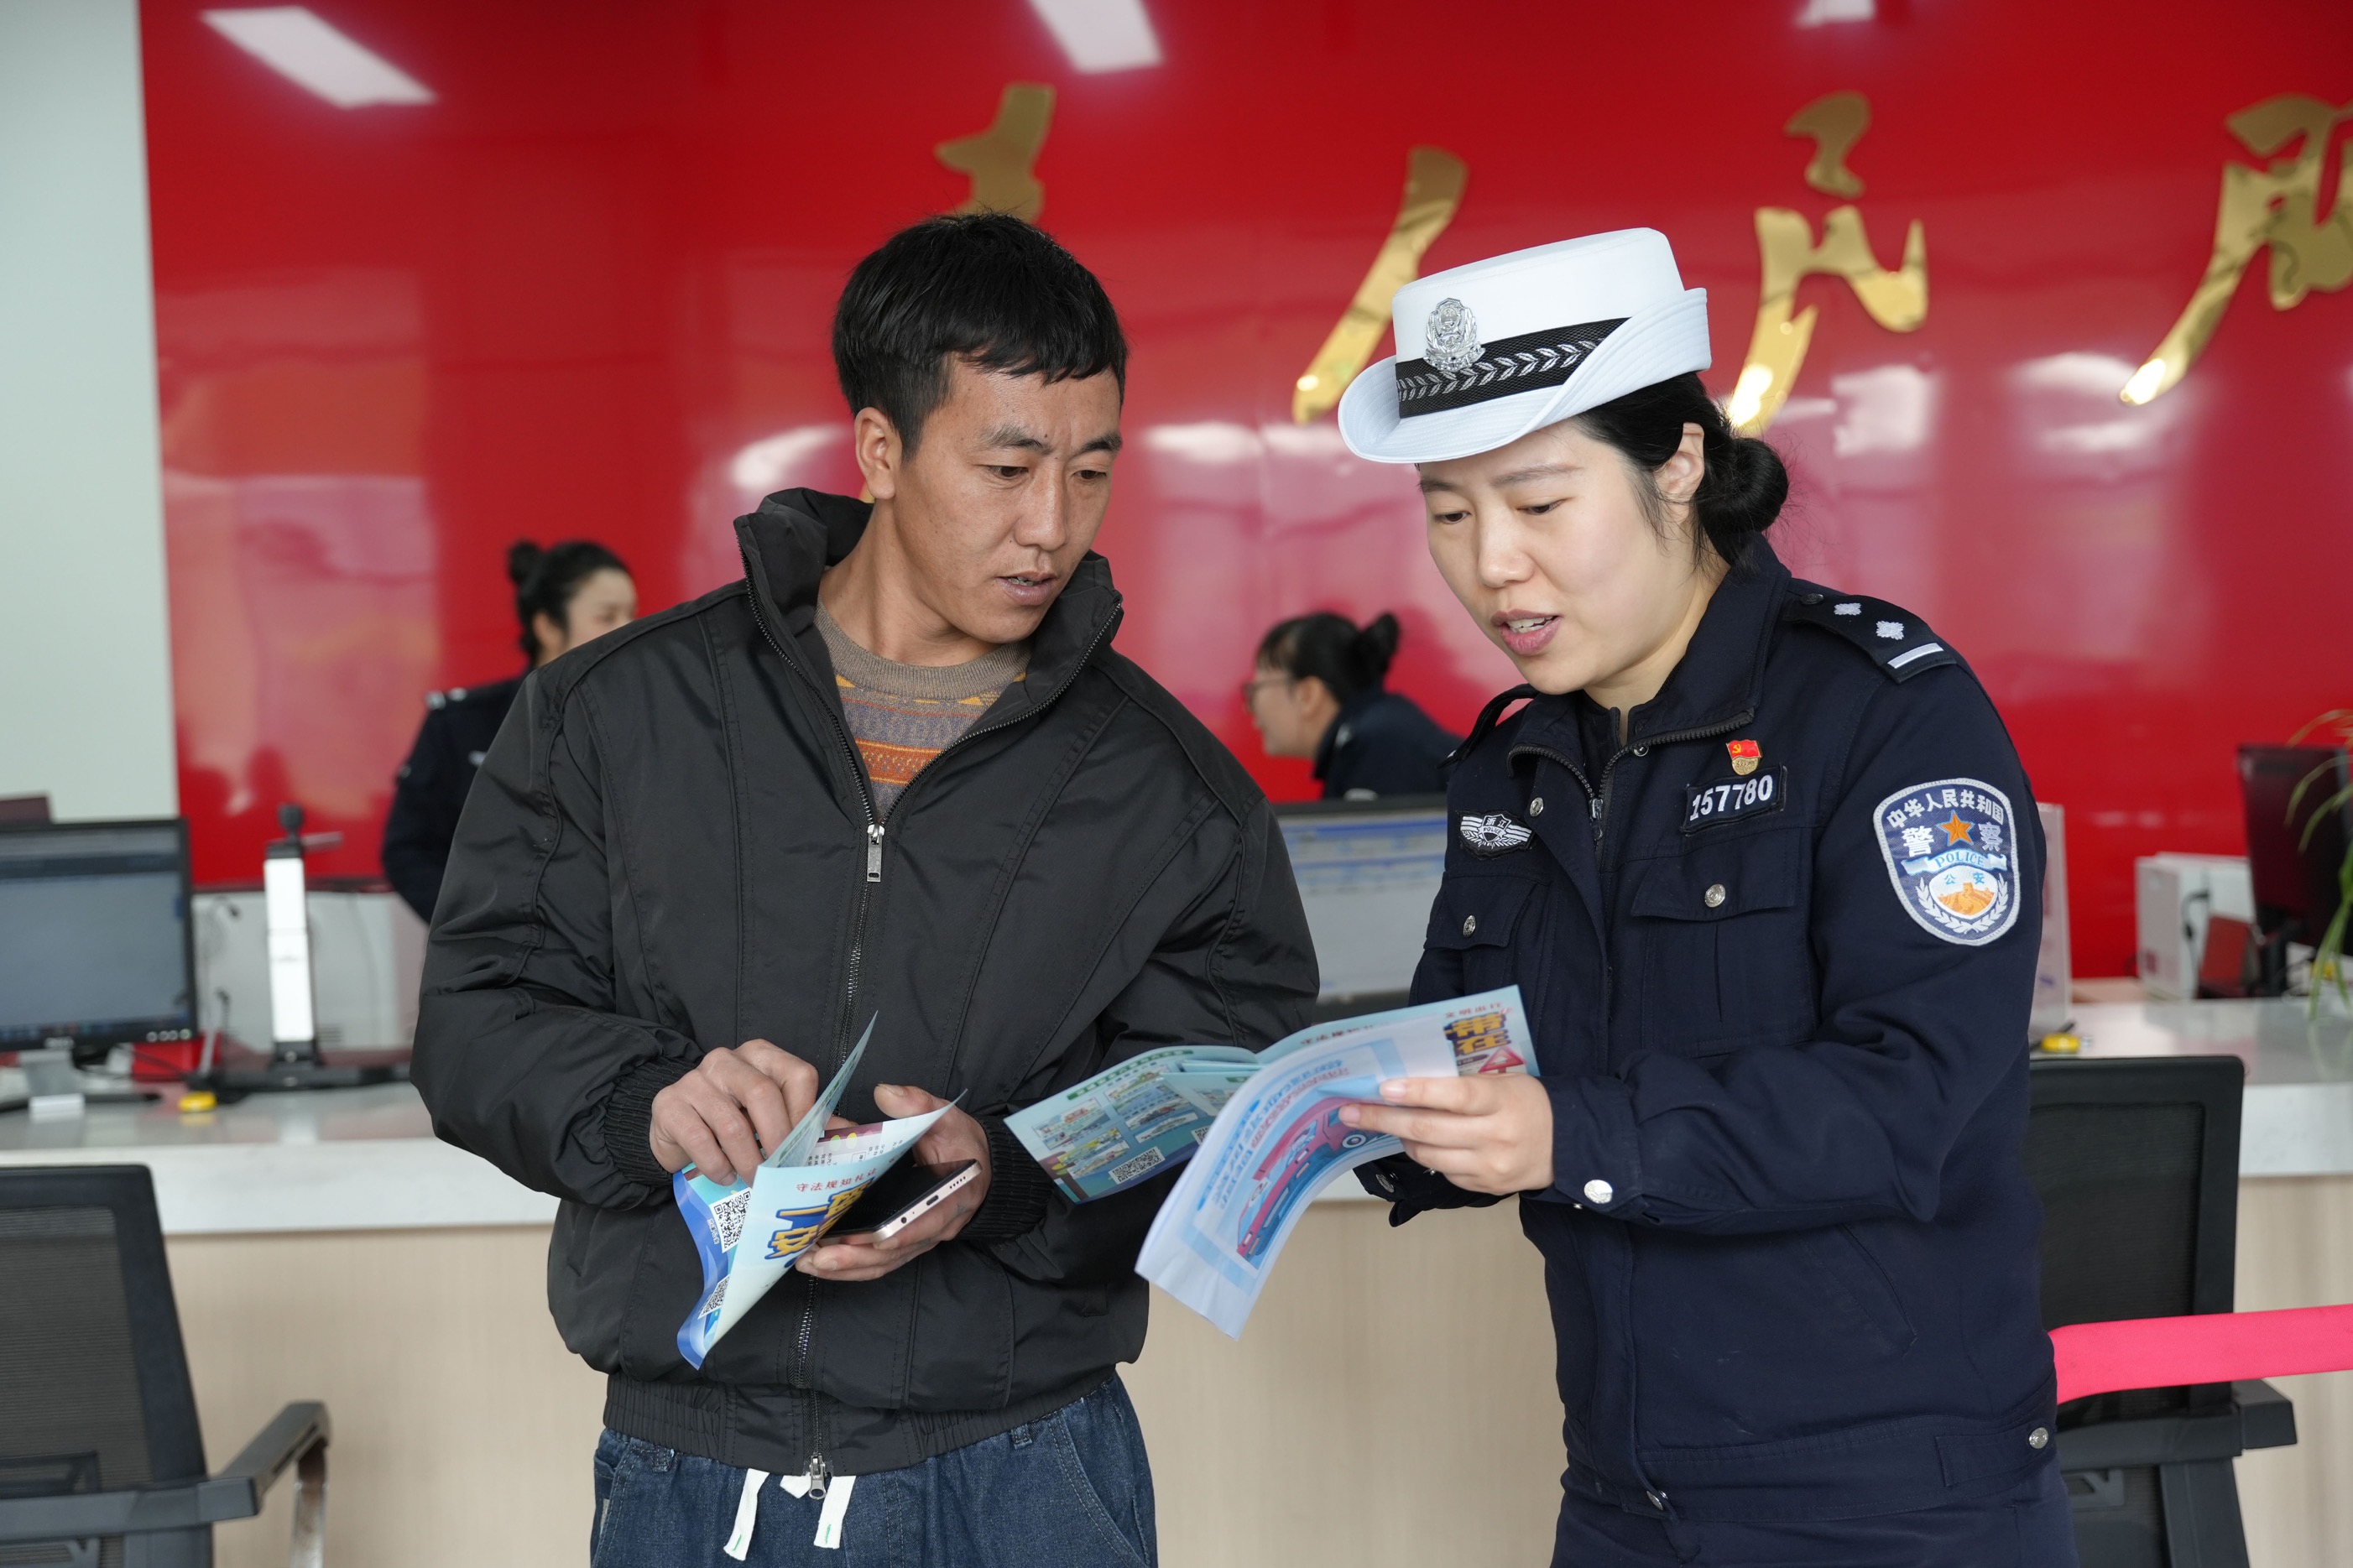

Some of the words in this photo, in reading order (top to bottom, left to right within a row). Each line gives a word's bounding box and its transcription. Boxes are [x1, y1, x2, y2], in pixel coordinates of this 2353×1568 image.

[1689, 774, 1773, 821] 157780
[1886, 789, 2004, 828] 中华人民共和国
[1483, 826, 1502, 836] POLICE
[1934, 851, 1985, 868] POLICE
